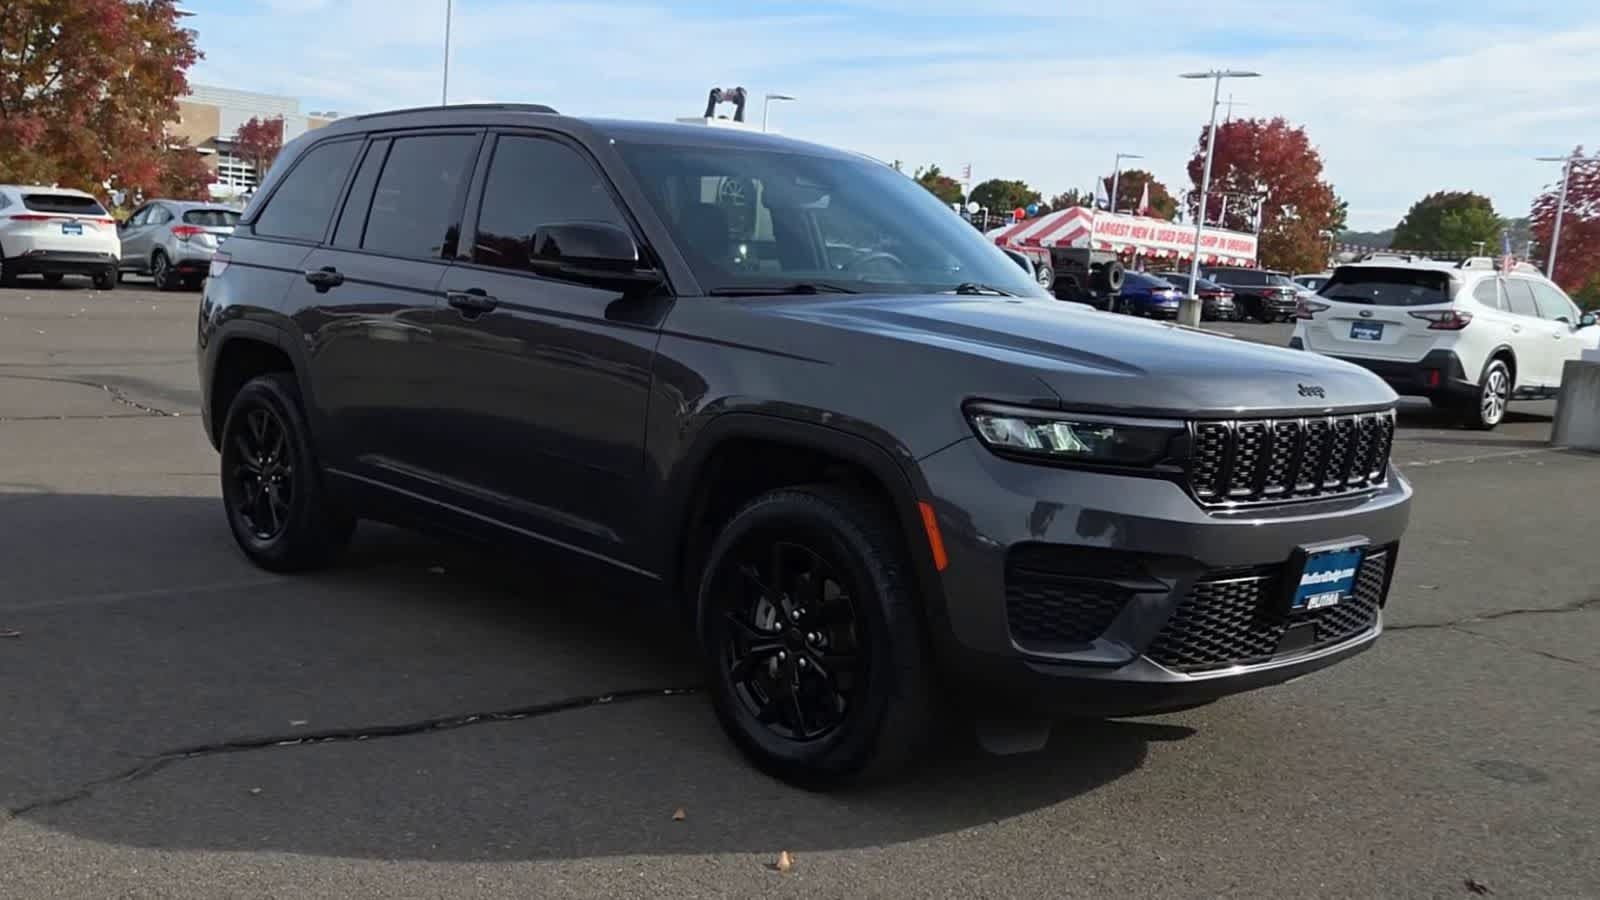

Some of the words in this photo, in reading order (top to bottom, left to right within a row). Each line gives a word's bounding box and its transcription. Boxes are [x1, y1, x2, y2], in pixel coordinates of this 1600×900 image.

[1095, 221, 1130, 236] LARGEST
[1130, 225, 1148, 239] NEW
[1156, 229, 1176, 242] USED
[1226, 239, 1254, 253] OREGON
[1297, 383, 1325, 399] Jeep
